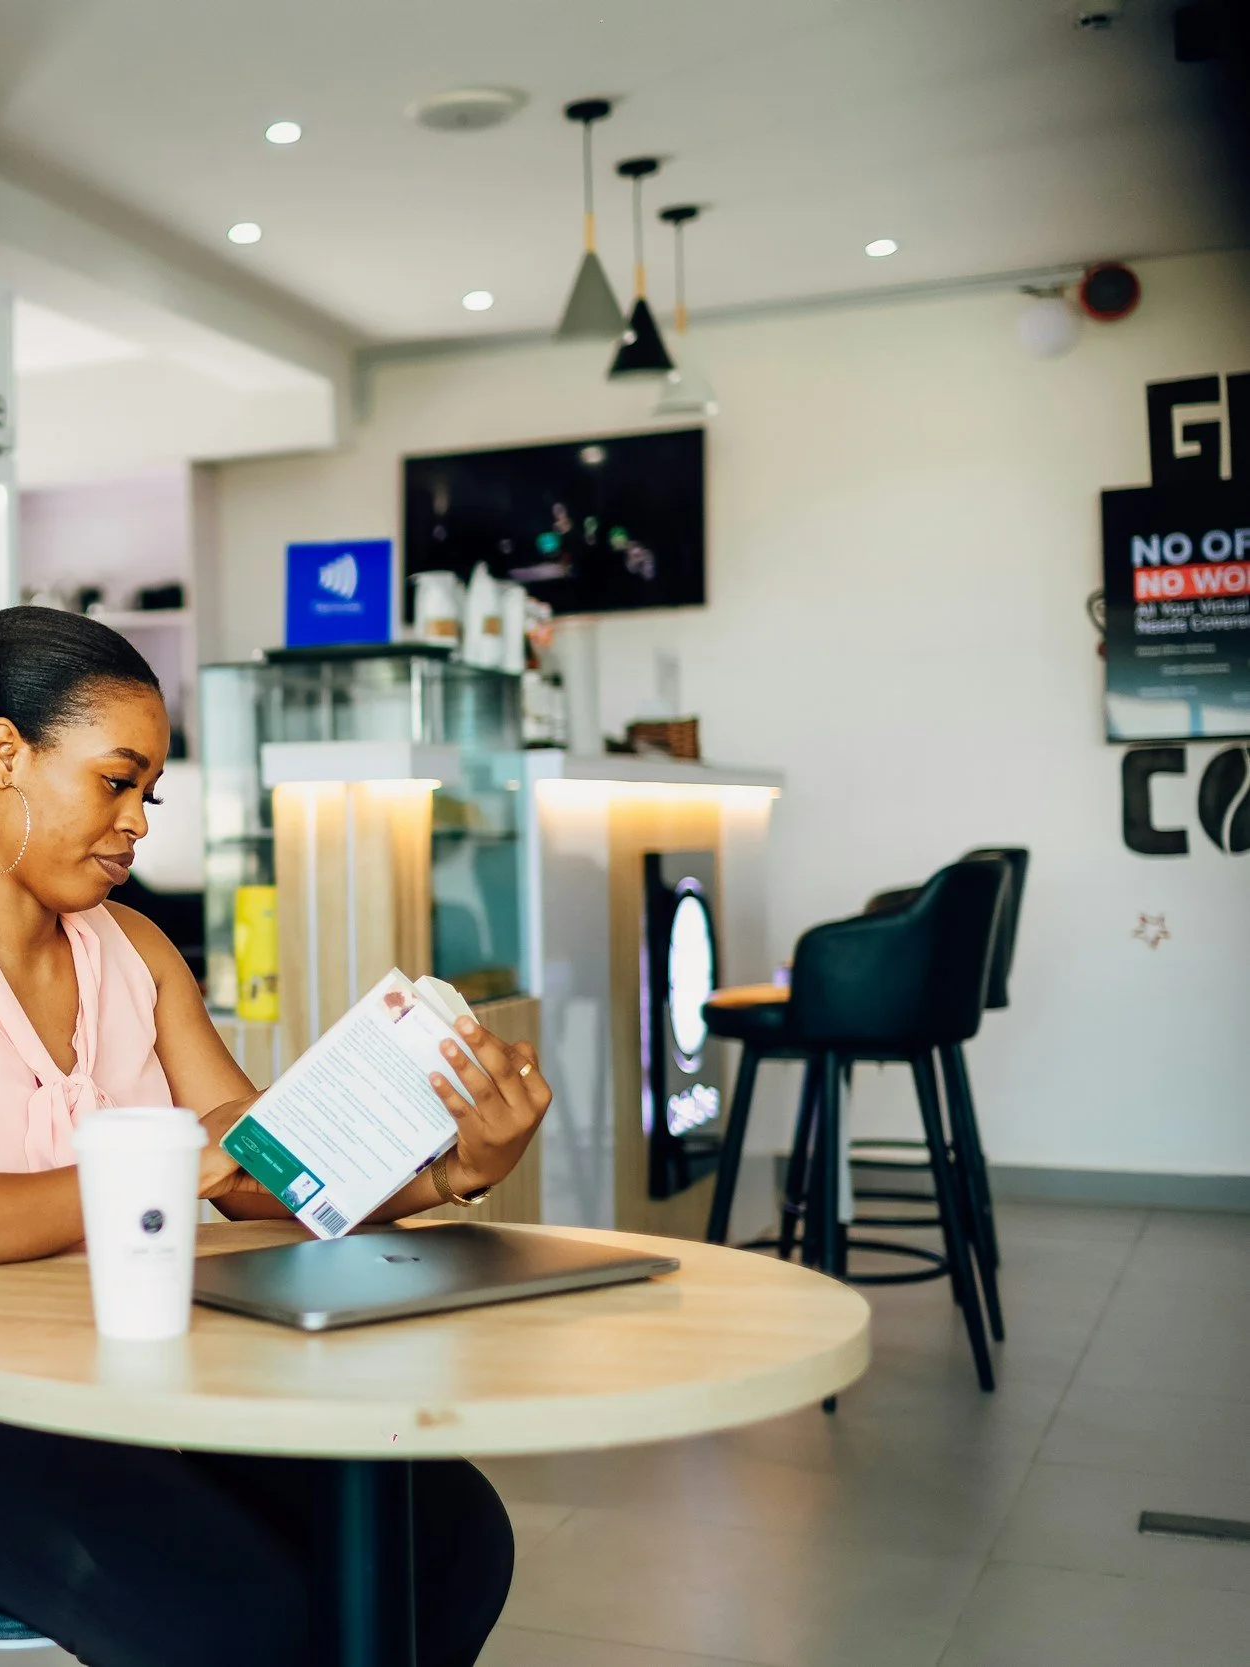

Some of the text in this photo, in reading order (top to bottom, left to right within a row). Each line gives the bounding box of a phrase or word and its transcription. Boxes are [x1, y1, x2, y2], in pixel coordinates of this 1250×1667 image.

[1132, 532, 1192, 565] NO
[1137, 569, 1185, 597] NO
[1199, 597, 1249, 615] Virtual
[1134, 617, 1188, 635] Needs
